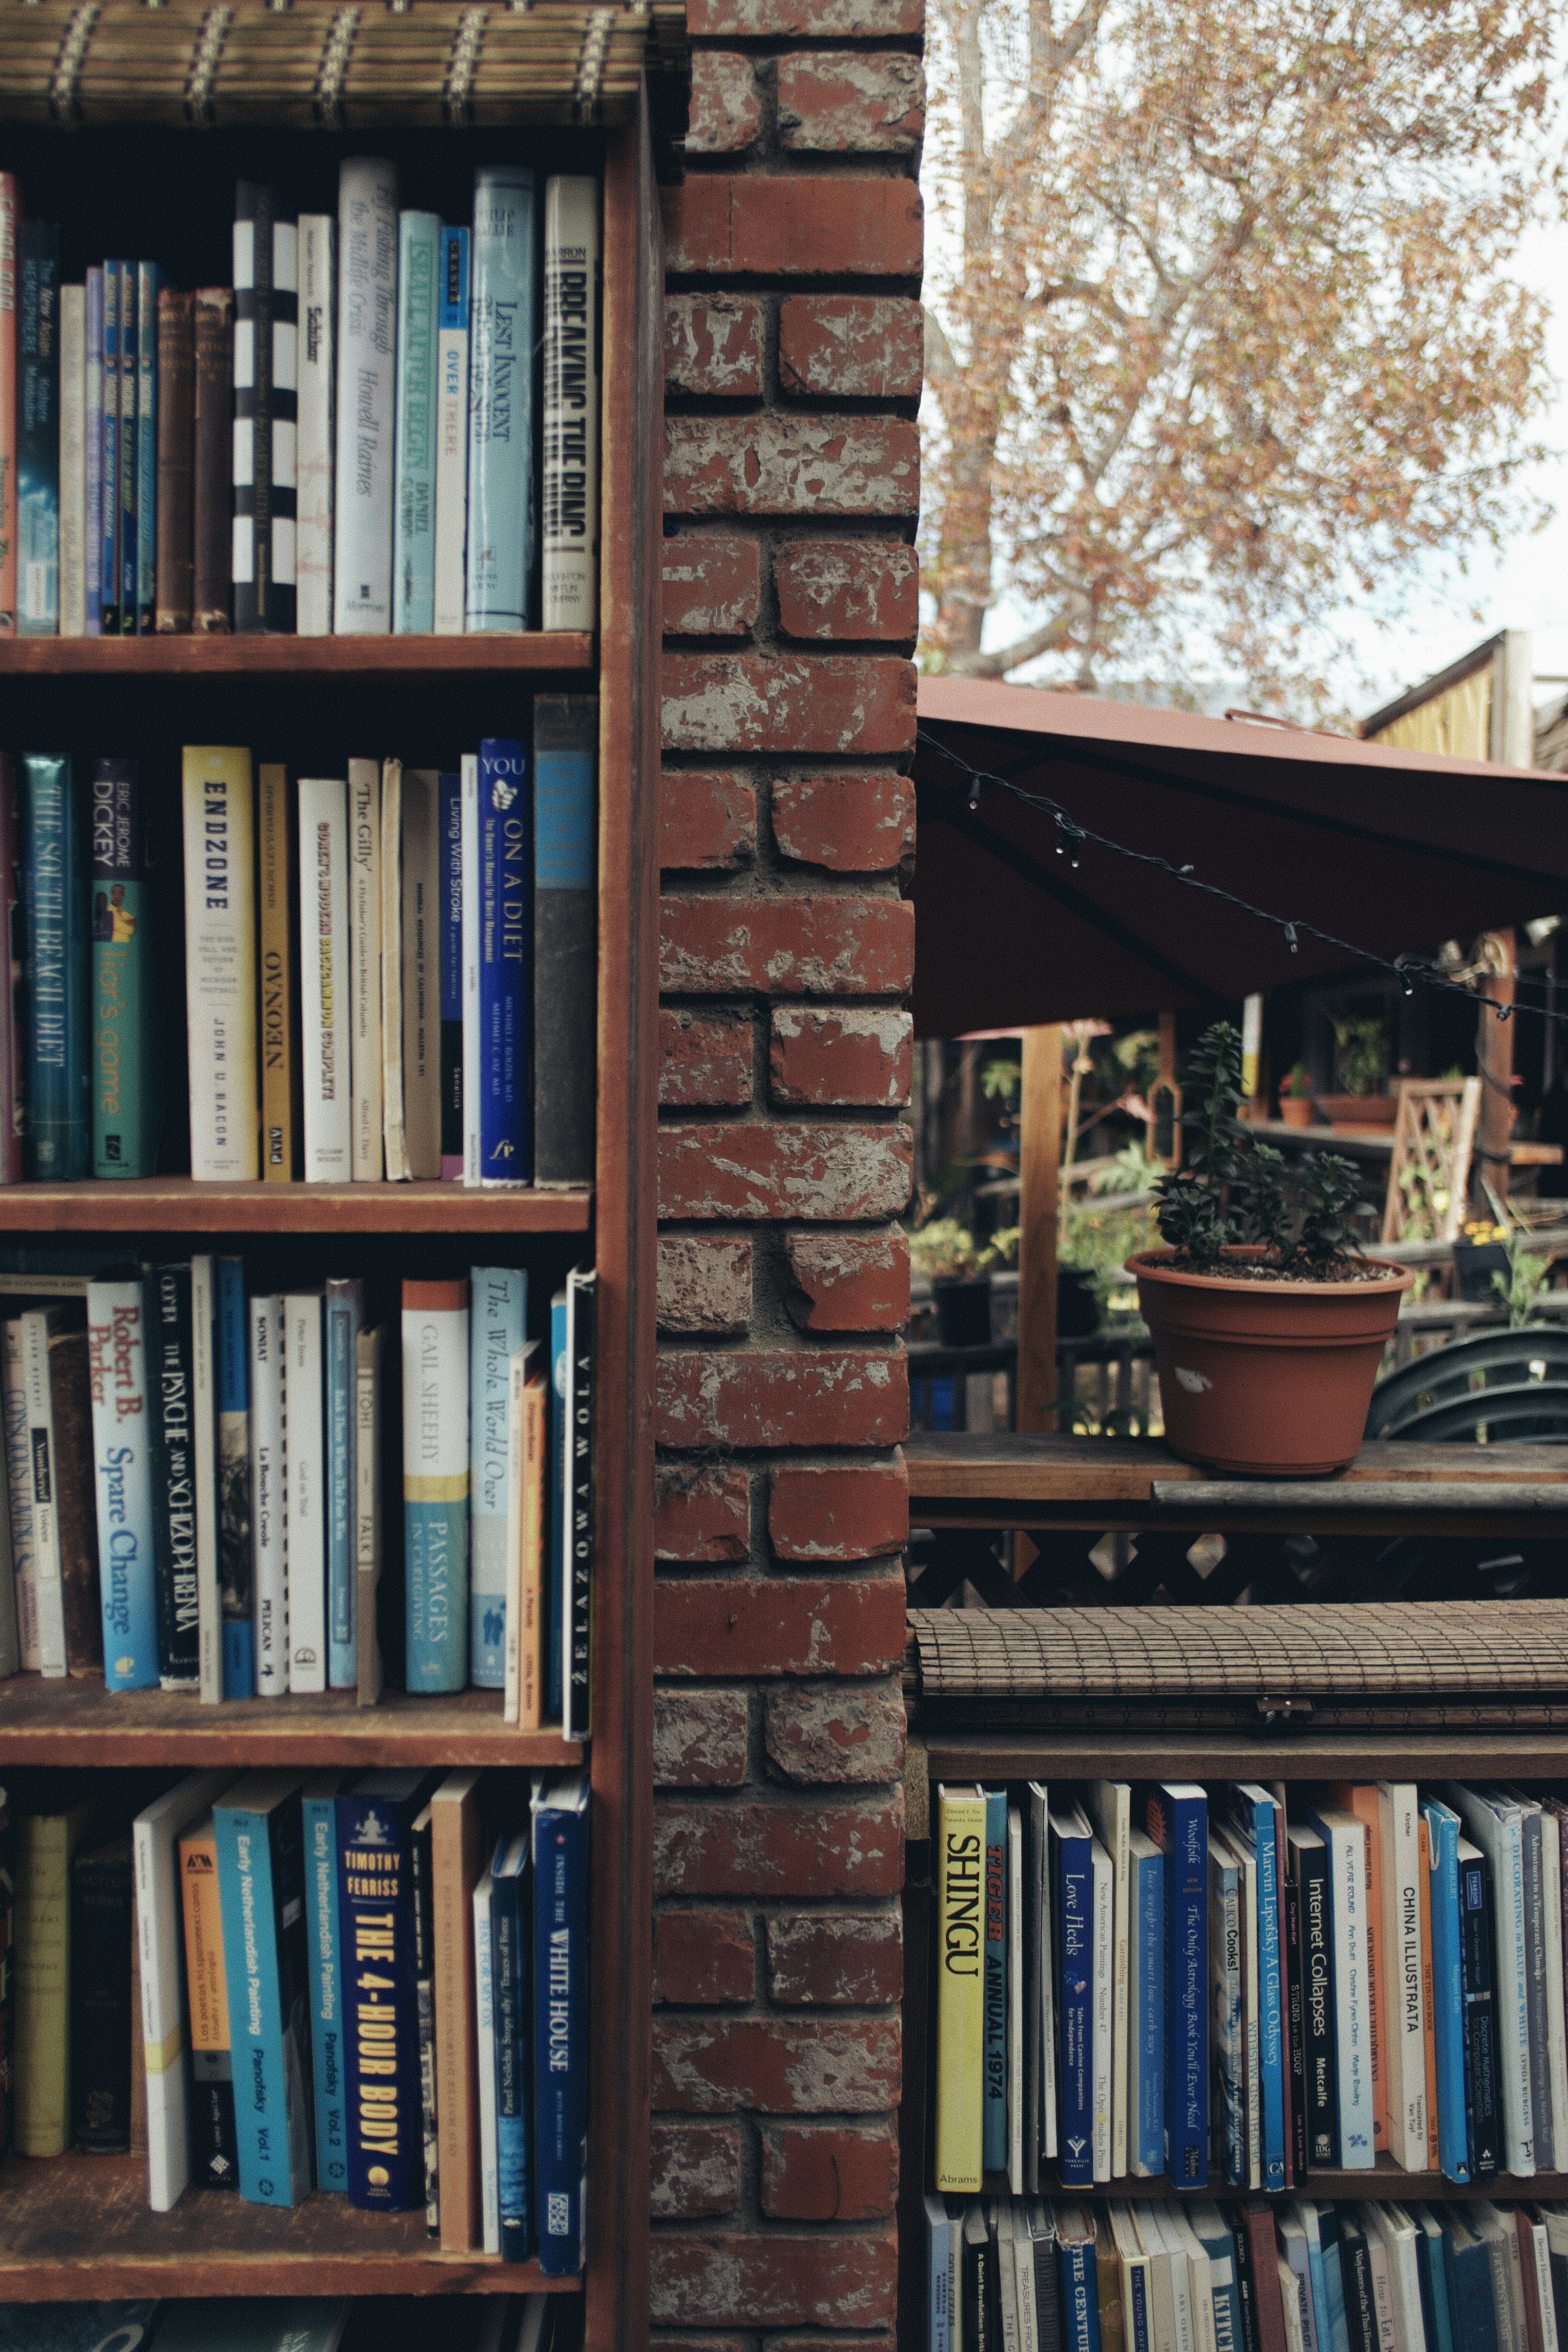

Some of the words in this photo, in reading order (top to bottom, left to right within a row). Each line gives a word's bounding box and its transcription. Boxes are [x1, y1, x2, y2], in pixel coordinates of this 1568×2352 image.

[495, 300, 517, 348] LEST
[545, 272, 586, 410] BREAKING
[446, 350, 459, 393] OVER
[357, 369, 377, 427] Howell
[492, 354, 516, 443] INNOCENT
[445, 400, 457, 456] THERE
[545, 417, 586, 468] THE
[356, 438, 377, 496] Raines
[545, 472, 586, 537] RING
[482, 757, 525, 775] YOU
[35, 785, 64, 833] THE
[117, 782, 130, 809] ERIC
[449, 797, 463, 839] Living
[94, 782, 113, 866] DICKEY
[117, 815, 130, 866] JEROME
[203, 782, 229, 910] ENDZONE
[504, 817, 523, 860] ON
[450, 842, 463, 875] With
[504, 873, 523, 887] A
[35, 841, 64, 924] SOUTH
[450, 879, 463, 922] Stroke
[504, 902, 523, 963] DIET
[36, 929, 64, 1002] BEACH
[100, 952, 125, 1017] liar's
[417, 964, 425, 973] OF
[36, 1013, 65, 1067] DIET
[94, 1030, 120, 1114] game
[486, 1280, 508, 1317] The
[113, 1305, 140, 1388] Robert
[164, 1344, 180, 1368] THE
[257, 1316, 268, 1361] SONIAT
[421, 1325, 439, 1372] GAIL
[486, 1328, 508, 1394] Whole
[89, 1325, 111, 1405] Parker
[116, 1396, 142, 1423] B.
[162, 1372, 188, 1443] PSYCHE
[421, 1381, 439, 1463] SHEEHY
[485, 1399, 507, 1455] World
[576, 1357, 589, 1456] WOLA
[170, 1452, 185, 1476] AND
[260, 1447, 270, 1461] La
[99, 1447, 133, 1522] Spare
[260, 1465, 270, 1506] Bouche
[484, 1460, 505, 1508] Over
[260, 1511, 271, 1548] Creole
[168, 1479, 198, 1630] SCHIZOPHRENIA
[106, 1531, 138, 1635] Change
[429, 1522, 448, 1642] PASSAGES
[262, 1599, 272, 1651] PELICAN
[237, 1836, 251, 1871] Early
[315, 1822, 328, 1857] Early
[345, 1851, 400, 1871] TIMOTHY
[1183, 1818, 1200, 1864] Woolfolk
[1531, 1835, 1540, 1882] Adventures
[347, 1877, 399, 1897] FERRISS
[1262, 1842, 1276, 1892] Marvin
[1513, 1844, 1523, 1929] DECORATING
[316, 1861, 332, 1959] Netherlandish
[946, 1833, 980, 1976] SHINGU
[987, 1844, 1004, 1941] TIGER
[1065, 1873, 1084, 1909] Love
[1099, 1882, 1108, 1902] New
[1187, 1905, 1200, 1924] The
[1225, 1888, 1237, 1928] CALICO
[1309, 1878, 1326, 1948] Internet
[1403, 1887, 1416, 1936] CHINA
[240, 1877, 258, 1974] Netherlandish
[356, 1914, 394, 1962] THE
[1065, 1914, 1084, 1955] Heels
[1098, 1904, 1108, 1942] American
[1183, 1929, 1200, 1956] Only
[1261, 1896, 1278, 1952] Lipofsky
[1516, 1933, 1523, 1942] in
[1532, 1901, 1541, 1944] Temperate
[550, 1928, 569, 1996] WHITE
[1096, 1944, 1108, 1978] Paintings
[1117, 1940, 1127, 1984] Garnishing
[1227, 1930, 1238, 1971] Cooks!
[1266, 1957, 1278, 1967] A
[1516, 1946, 1525, 1978] BLUE
[1533, 1947, 1543, 1980] Climate
[245, 1978, 262, 2035] Painting
[319, 1962, 335, 2018] Painting
[987, 1955, 1004, 2045] ANNUAL
[1098, 1987, 1107, 2020] Number
[1183, 1960, 1200, 2009] Astrology
[1266, 1976, 1279, 2006] Glass
[1309, 1953, 1328, 2036] Collapses
[1404, 1941, 1418, 2032] ILLUSTRATA
[1518, 1983, 1526, 1998] and
[358, 1973, 395, 2074] 4-HOUR
[550, 2000, 569, 2071] HOUSE
[1076, 2007, 1085, 2024] Tales
[1076, 2025, 1085, 2041] from
[1098, 2024, 1107, 2033] 47
[1187, 2013, 1200, 2038] Book
[1265, 2009, 1280, 2066] Odyssey
[1481, 2016, 1490, 2053] Discrete
[1518, 2004, 1527, 2046] WHITE
[323, 2032, 339, 2096] Panofsky
[1067, 2018, 1076, 2066] Independence
[1076, 2043, 1085, 2067] Canine
[1187, 2042, 1200, 2069] You'll
[251, 2049, 267, 2113] Panofsky
[988, 2050, 1005, 2100] 1974
[1075, 2069, 1085, 2110] Companions
[1187, 2073, 1200, 2097] Ever
[1316, 2058, 1327, 2106] Metcalfe
[1481, 2057, 1493, 2116] Mathematics
[1519, 2053, 1529, 2083] LYNDA
[359, 2085, 397, 2154] BODY
[1187, 2102, 1200, 2129] Need
[1521, 2086, 1530, 2126] BURGESS
[940, 2175, 978, 2184] Abrams
[1073, 2249, 1084, 2281] THE
[1354, 2249, 1365, 2289] Wayfarers
[1022, 2265, 1031, 2324] TREASURES
[1298, 2274, 1307, 2313] PRIVATE
[1360, 2299, 1368, 2312] the
[1302, 2320, 1312, 2347] PILOT
[1361, 2312, 1370, 2330] Thai
